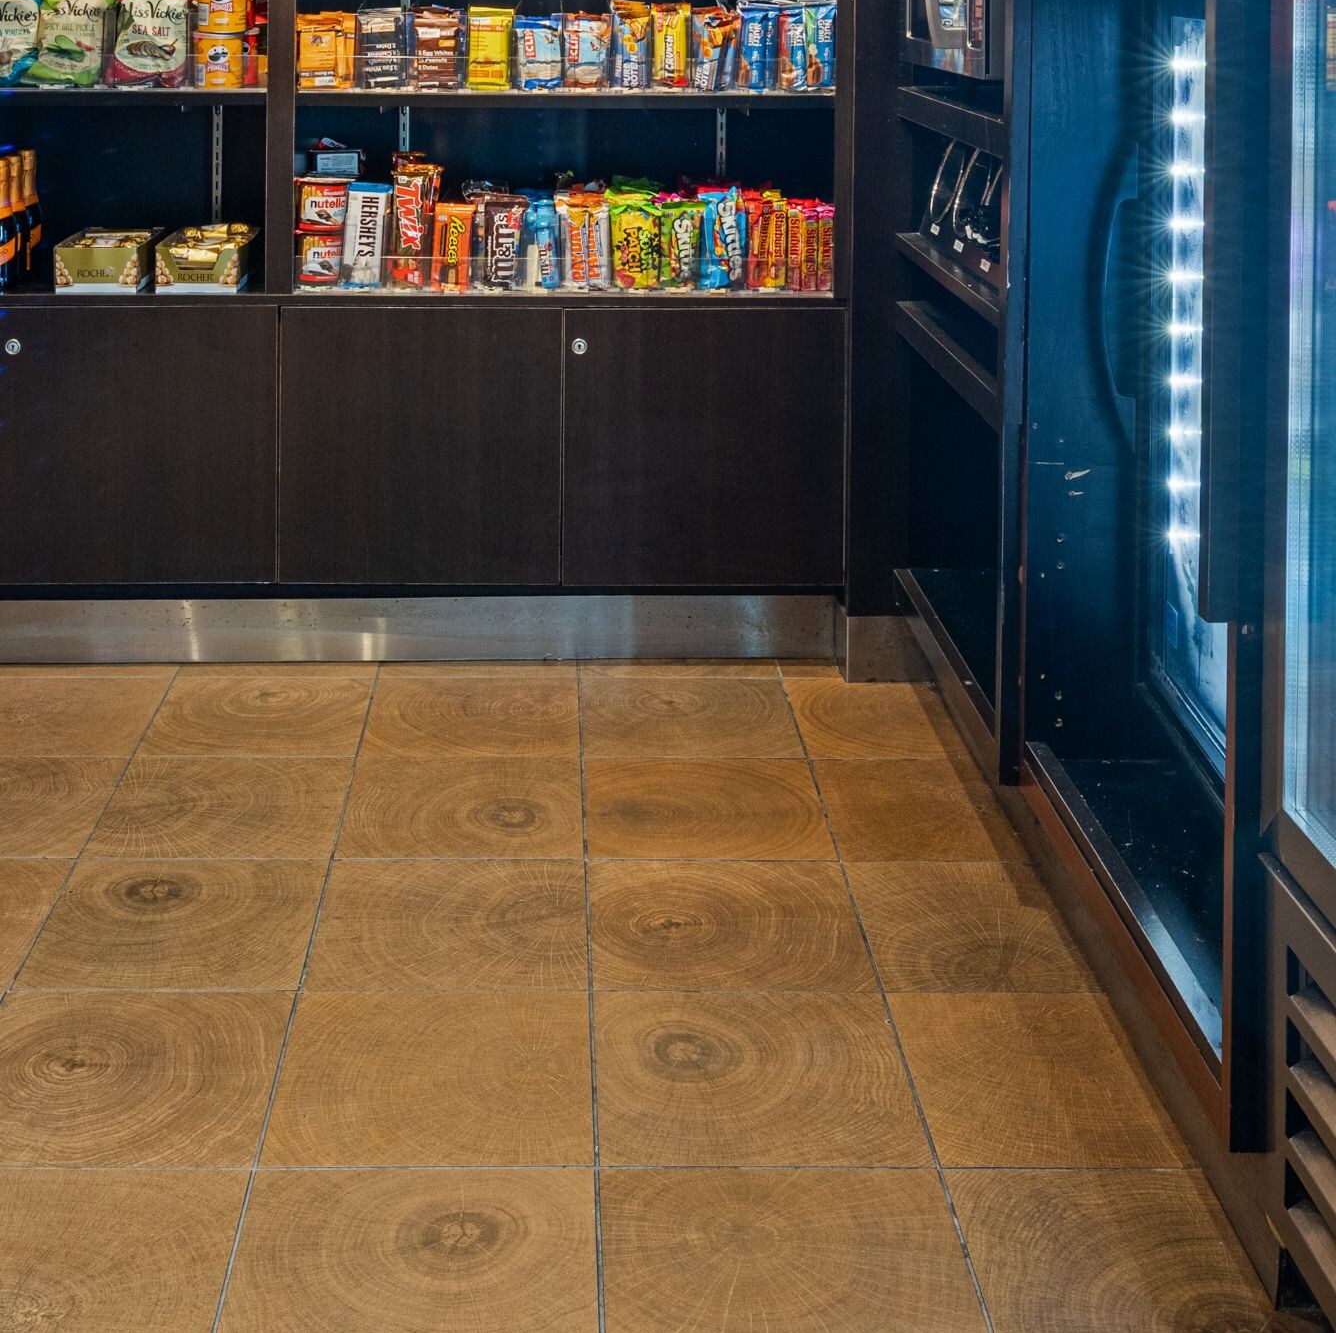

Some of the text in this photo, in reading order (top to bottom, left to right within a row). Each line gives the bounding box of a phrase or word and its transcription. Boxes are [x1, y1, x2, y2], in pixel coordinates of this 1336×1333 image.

[132, 25, 171, 37] SEA SALT
[824, 19, 832, 42] Nutri
[664, 35, 674, 69] CRUNCH
[310, 198, 345, 209] nutella
[357, 196, 380, 257] HERSHEY'S
[774, 212, 785, 259] Starburst
[623, 227, 641, 274] PATCH
[178, 273, 214, 282] ROCHER
